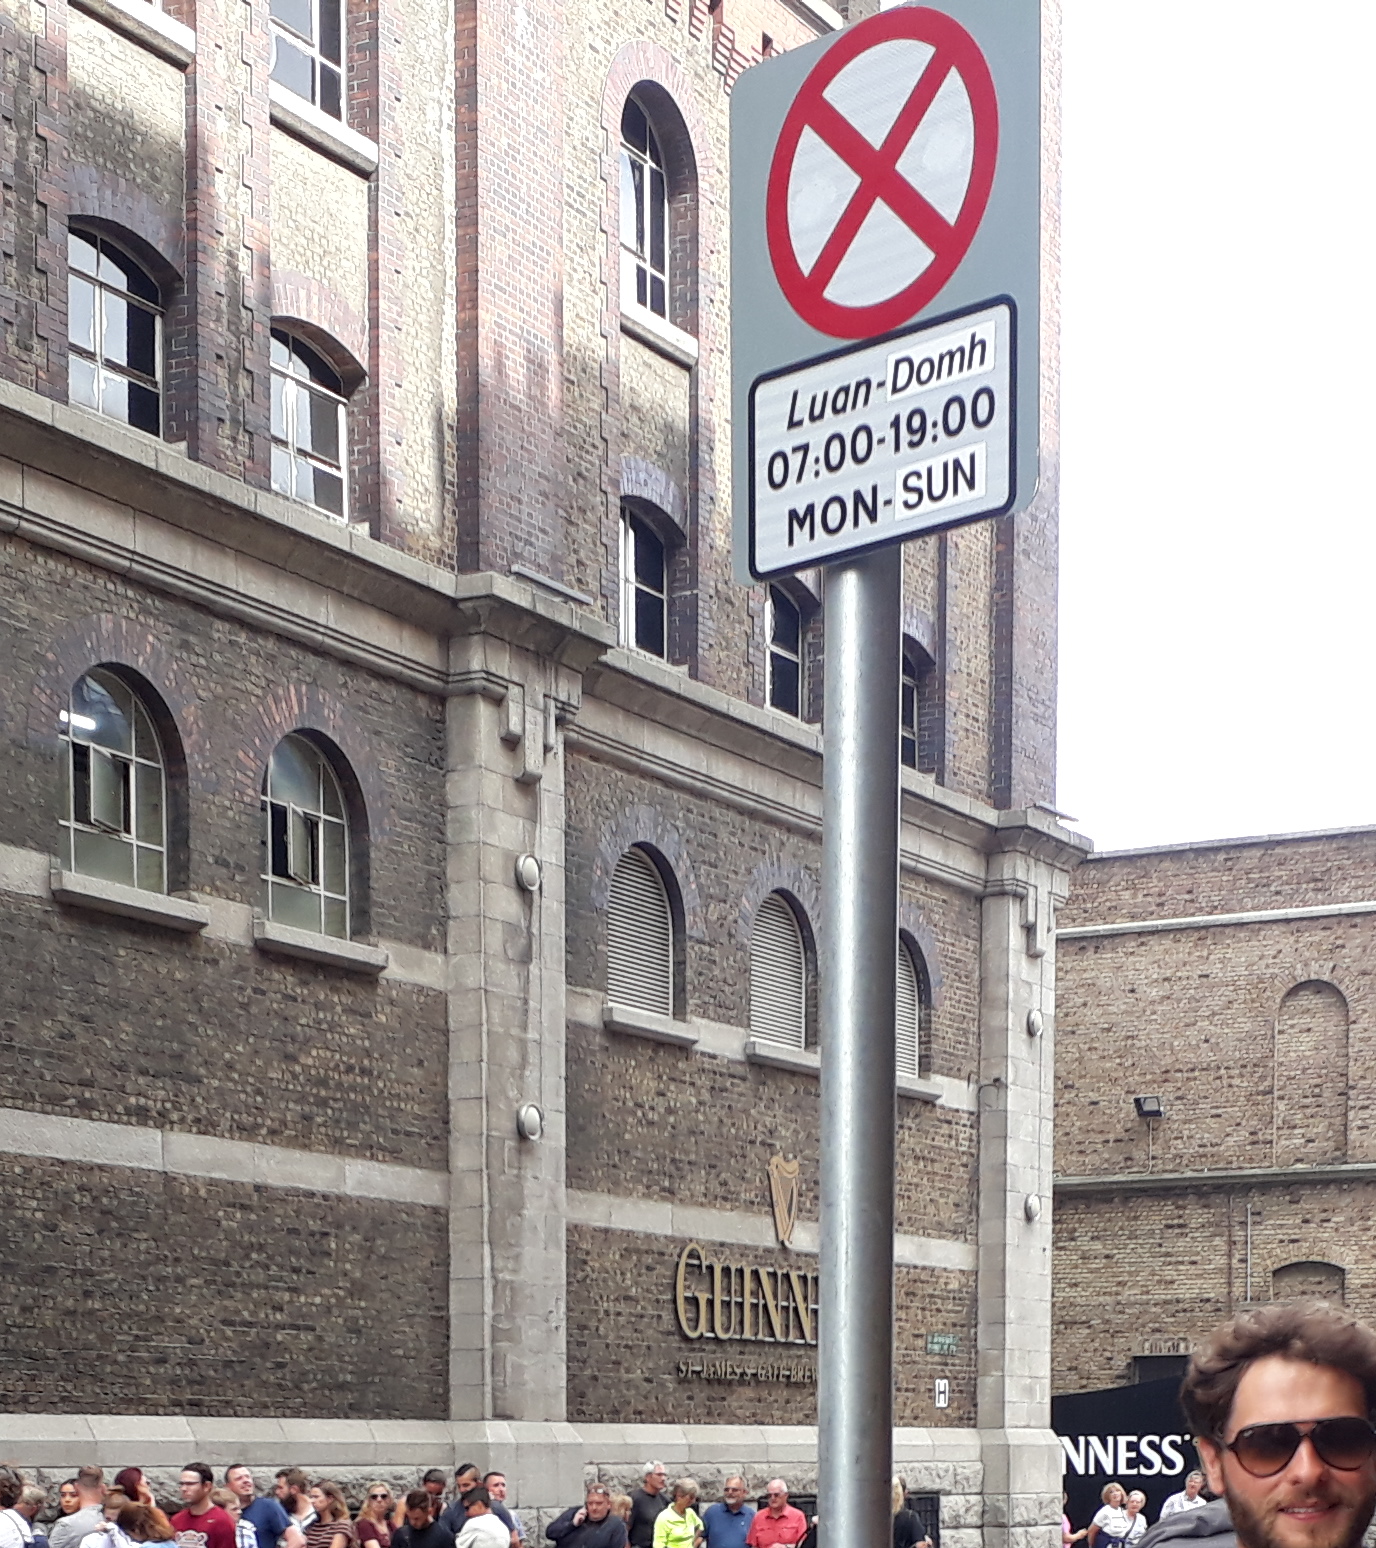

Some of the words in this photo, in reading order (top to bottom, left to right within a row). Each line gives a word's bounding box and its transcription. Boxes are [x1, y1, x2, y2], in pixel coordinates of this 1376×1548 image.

[787, 331, 988, 431] Luan-Domh
[767, 386, 996, 490] 07:00-19:00
[787, 451, 976, 547] MON-SUN
